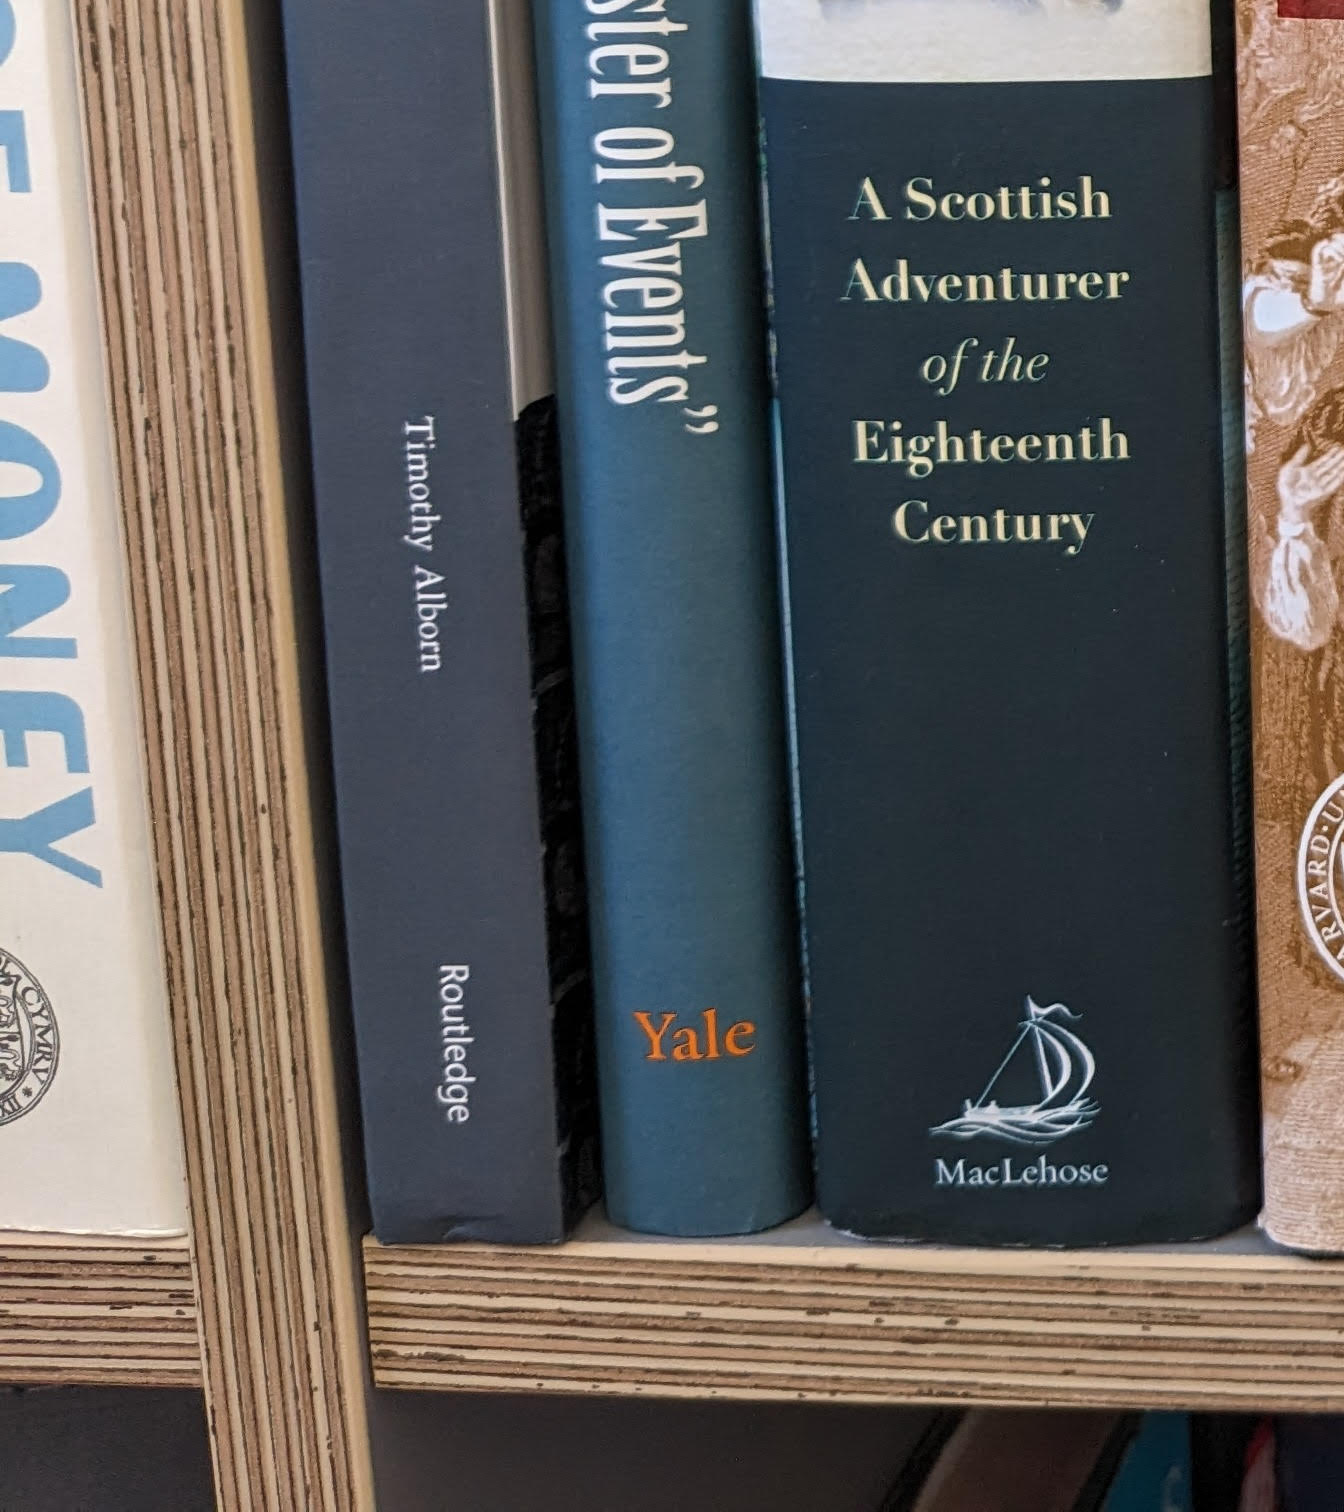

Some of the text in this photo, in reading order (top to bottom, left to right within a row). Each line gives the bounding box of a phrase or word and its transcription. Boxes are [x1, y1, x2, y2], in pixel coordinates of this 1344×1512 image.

[594, 127, 706, 191] of
[846, 175, 1112, 221] A Scottish
[841, 258, 1131, 305] Adventurer
[920, 338, 1050, 396] of the
[851, 417, 1132, 478] Eighteenth
[402, 415, 443, 675] Timothy Alborn
[893, 500, 1097, 557] Century
[437, 963, 471, 1124] Routledge
[633, 1008, 757, 1065] Yale
[933, 1156, 1110, 1189] MacLehose
